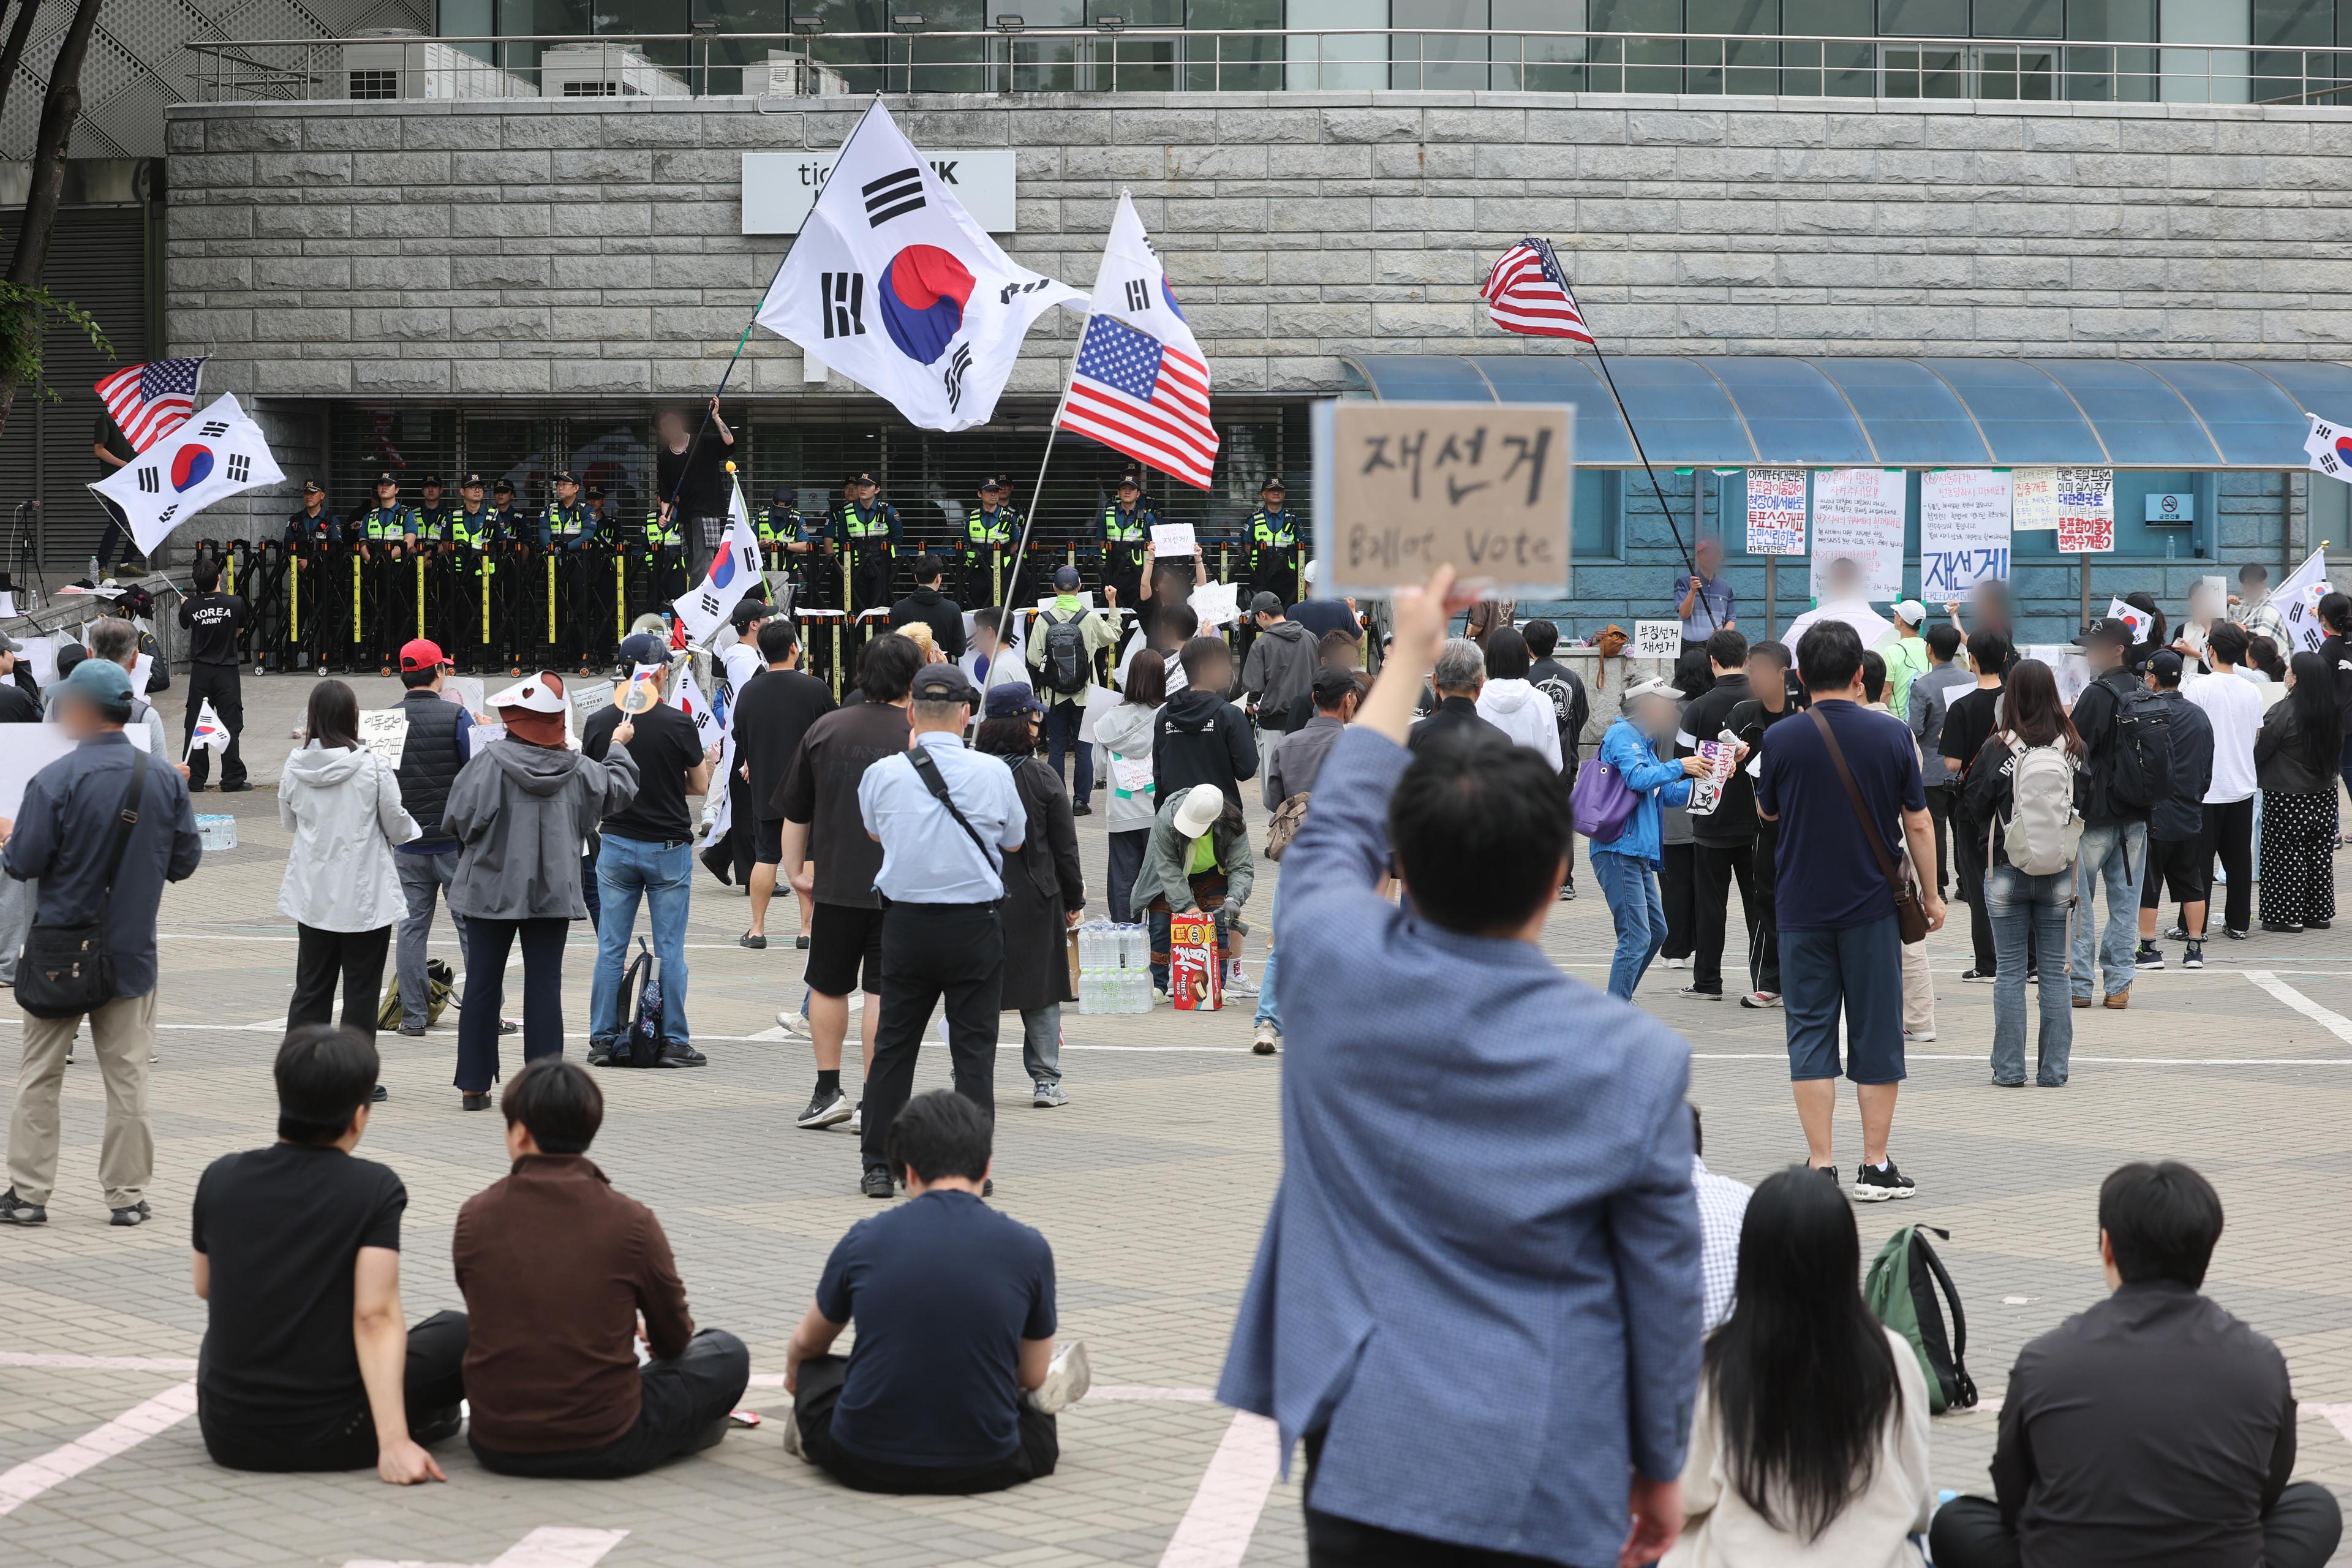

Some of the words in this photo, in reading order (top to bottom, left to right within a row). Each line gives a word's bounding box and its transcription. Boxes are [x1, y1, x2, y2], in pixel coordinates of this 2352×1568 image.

[1361, 426, 1553, 506] 재선거
[1833, 471, 1852, 484] 끝까지
[1856, 472, 1879, 484] 평화를
[2015, 481, 2049, 497] 집중개표
[2058, 482, 2073, 494] 이미
[2059, 505, 2108, 519] 이제부터는
[1163, 535, 1189, 544] 재선거!
[1349, 524, 1436, 567] Ballot
[1465, 526, 1554, 565] Vote
[1749, 529, 1796, 548] 국민신뢰회복
[192, 608, 232, 623] KOREA
[1640, 625, 1678, 640] 부정선거
[1641, 641, 1675, 654] 재선거
[364, 712, 404, 730] 이동없이
[1181, 928, 1186, 939] 가격
[1172, 944, 1208, 972] 情
[1102, 982, 1121, 994] 풀무원
